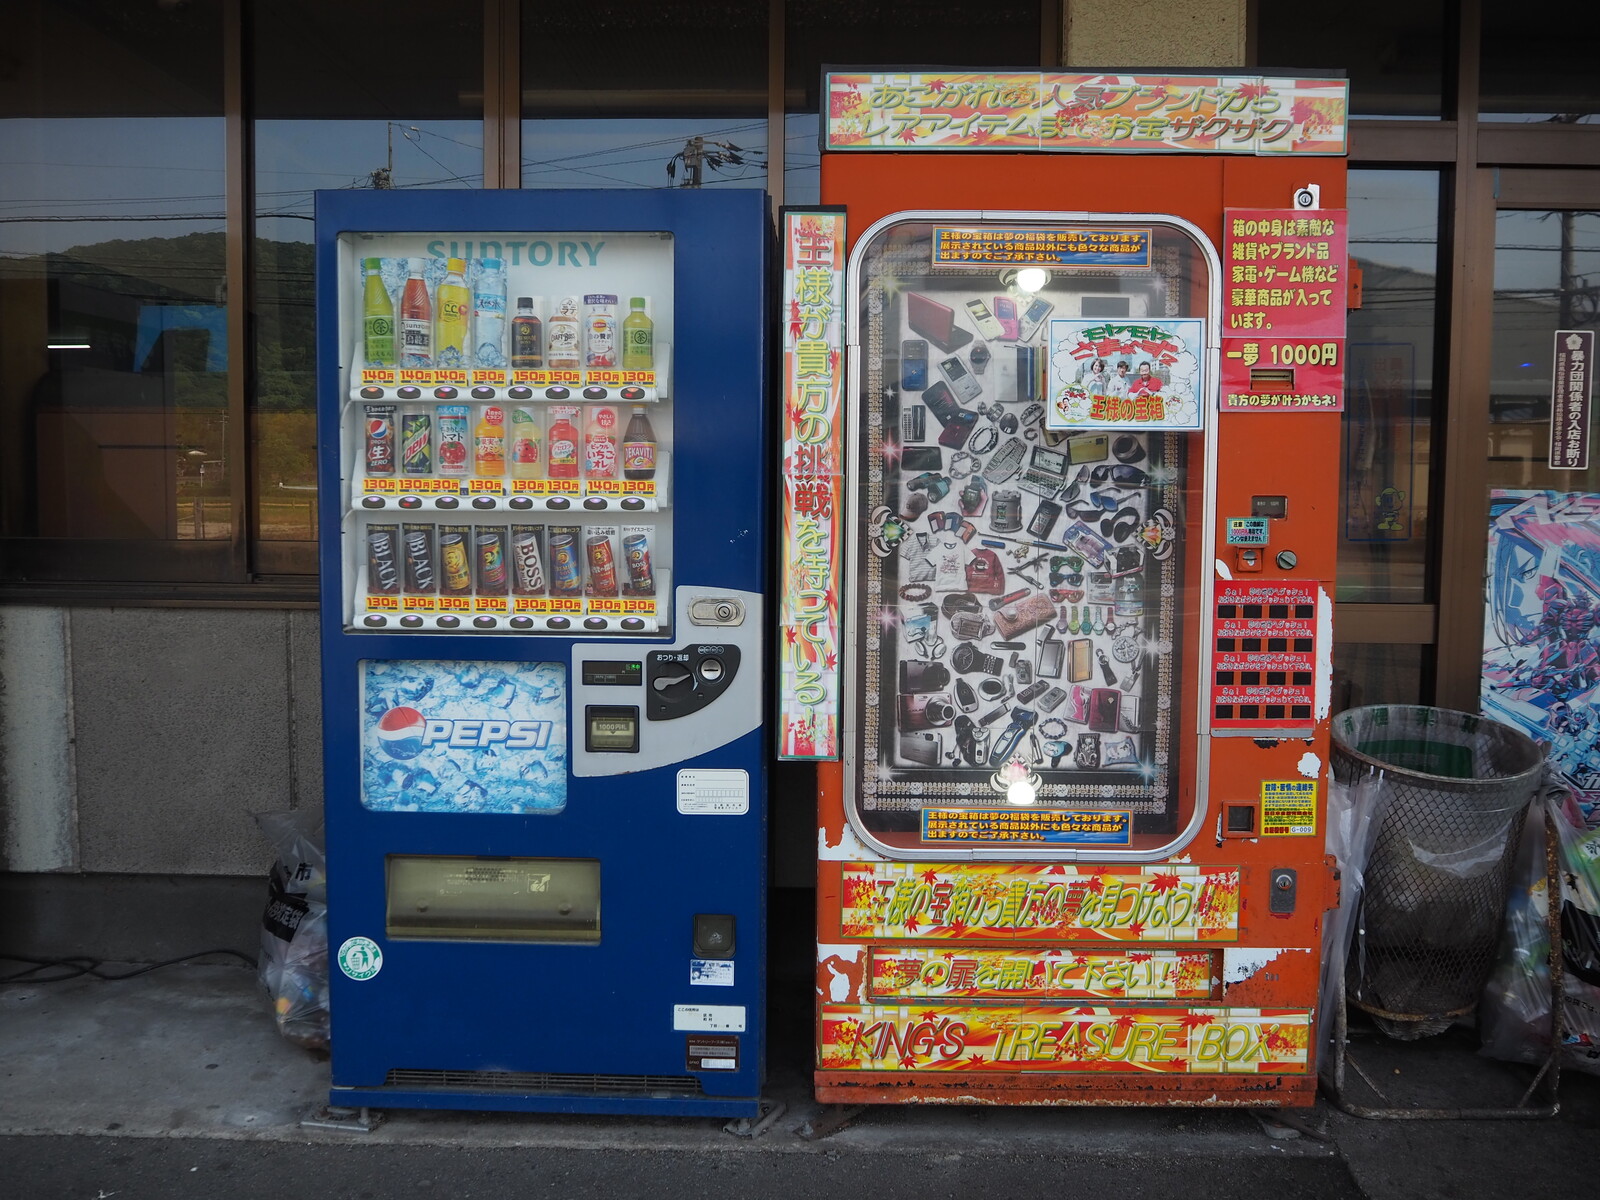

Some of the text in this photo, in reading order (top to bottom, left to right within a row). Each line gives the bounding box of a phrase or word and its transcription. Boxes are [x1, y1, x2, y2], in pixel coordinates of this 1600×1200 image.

[869, 83, 1282, 114] あこがれの人気ブランドから
[1232, 219, 1335, 237] 箱の中身は素敵な
[941, 231, 1146, 243] 王様の宝箱は夢の福袋を販売しております。
[940, 241, 1141, 253] 展示されている商品以外にも色々な商品が
[1232, 242, 1330, 260] 雑貨やブランド品
[940, 252, 1062, 262] 出ますのでご了承下さい。
[1232, 265, 1339, 283] 家電・ゲーム機など
[1231, 288, 1332, 306] 豪華商品が入って
[1231, 312, 1272, 330] います。
[374, 319, 389, 335] 茶
[634, 330, 648, 344] 茶
[1227, 343, 1337, 366] 一夢 1000円
[362, 371, 394, 380] 140円
[400, 371, 431, 380] 140円
[434, 371, 466, 380] 140円
[473, 371, 505, 380] 130円
[514, 372, 546, 381] 150円
[548, 372, 580, 381] 150円
[588, 372, 619, 381] 130円
[622, 372, 654, 381] 130円
[1090, 395, 1165, 421] 王様の宝箱
[1566, 351, 1584, 467] 暴力団関係者の入店お断り
[441, 433, 464, 442] トマト
[372, 446, 383, 460] 生
[587, 449, 615, 460] いちご
[593, 460, 610, 470] オレ
[364, 480, 395, 489] 130円
[399, 480, 430, 489] 130円
[470, 481, 501, 490] 130円
[512, 481, 544, 490] 130円
[546, 481, 578, 490] 130円
[587, 481, 619, 490] 140円
[622, 481, 655, 490] 130円
[373, 540, 398, 590] BLACK
[409, 540, 435, 589] BLACK
[520, 543, 542, 590] BOSS
[366, 597, 397, 606] 130円
[403, 598, 434, 607] 130円
[438, 599, 469, 608] 130円
[475, 599, 506, 608] 130円
[515, 600, 547, 609] 130円
[549, 600, 581, 609] 130円
[590, 601, 621, 609] 130円
[623, 601, 655, 610] 130円
[657, 654, 689, 662] おつり・返却
[421, 719, 553, 751] PEPSI
[928, 811, 1128, 823] 王様の宝箱は夢の福袋を販売しております。
[927, 821, 1123, 832] 展示されている商品以外にも色々な商品が
[927, 831, 1046, 841] 出ますのでご了承下さい。
[850, 1018, 1280, 1064] KING'S TREASURE BOX
